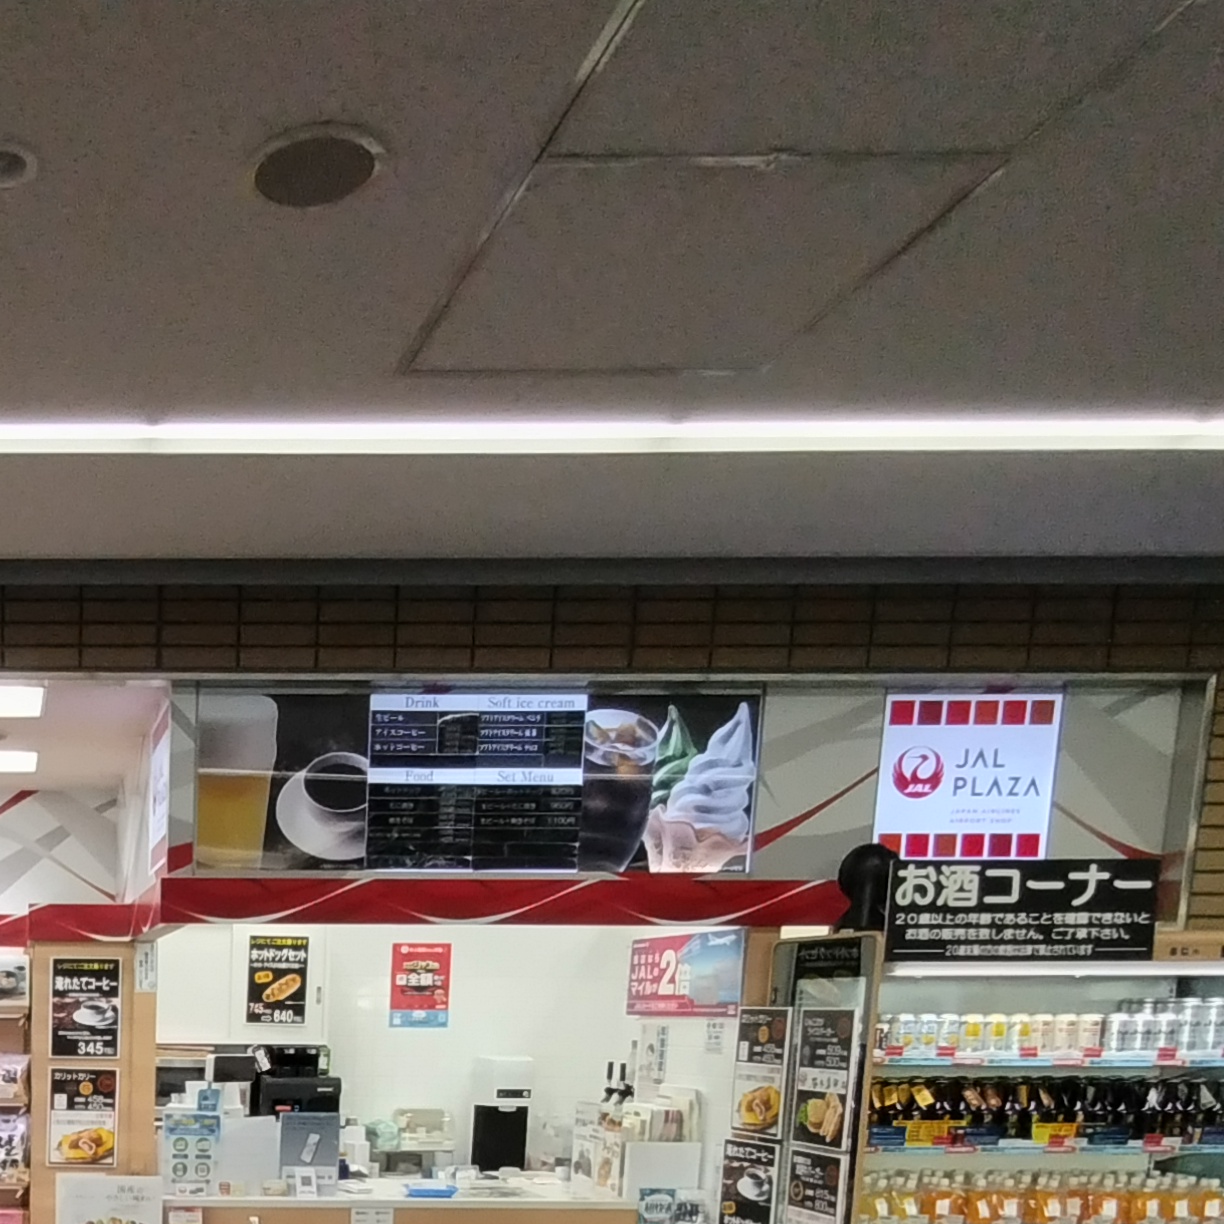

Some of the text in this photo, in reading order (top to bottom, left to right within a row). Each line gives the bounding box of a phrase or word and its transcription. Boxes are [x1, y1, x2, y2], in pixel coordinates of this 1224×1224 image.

[405, 697, 439, 708] Drink
[488, 697, 575, 708] Soft ice cream
[376, 729, 426, 737] アイスコーヒー
[375, 743, 425, 751] ホットコーヒー
[955, 748, 1005, 768] JAL
[405, 771, 434, 781] Food
[497, 771, 554, 782] Set Menu
[903, 783, 933, 794] JAL
[953, 777, 1040, 797] PLAZA
[894, 863, 1153, 907] お酒コーナー
[250, 949, 307, 963] ホットドッグセット
[631, 964, 659, 980] JALの
[273, 1009, 294, 1024] 640
[78, 1041, 104, 1055] 345
